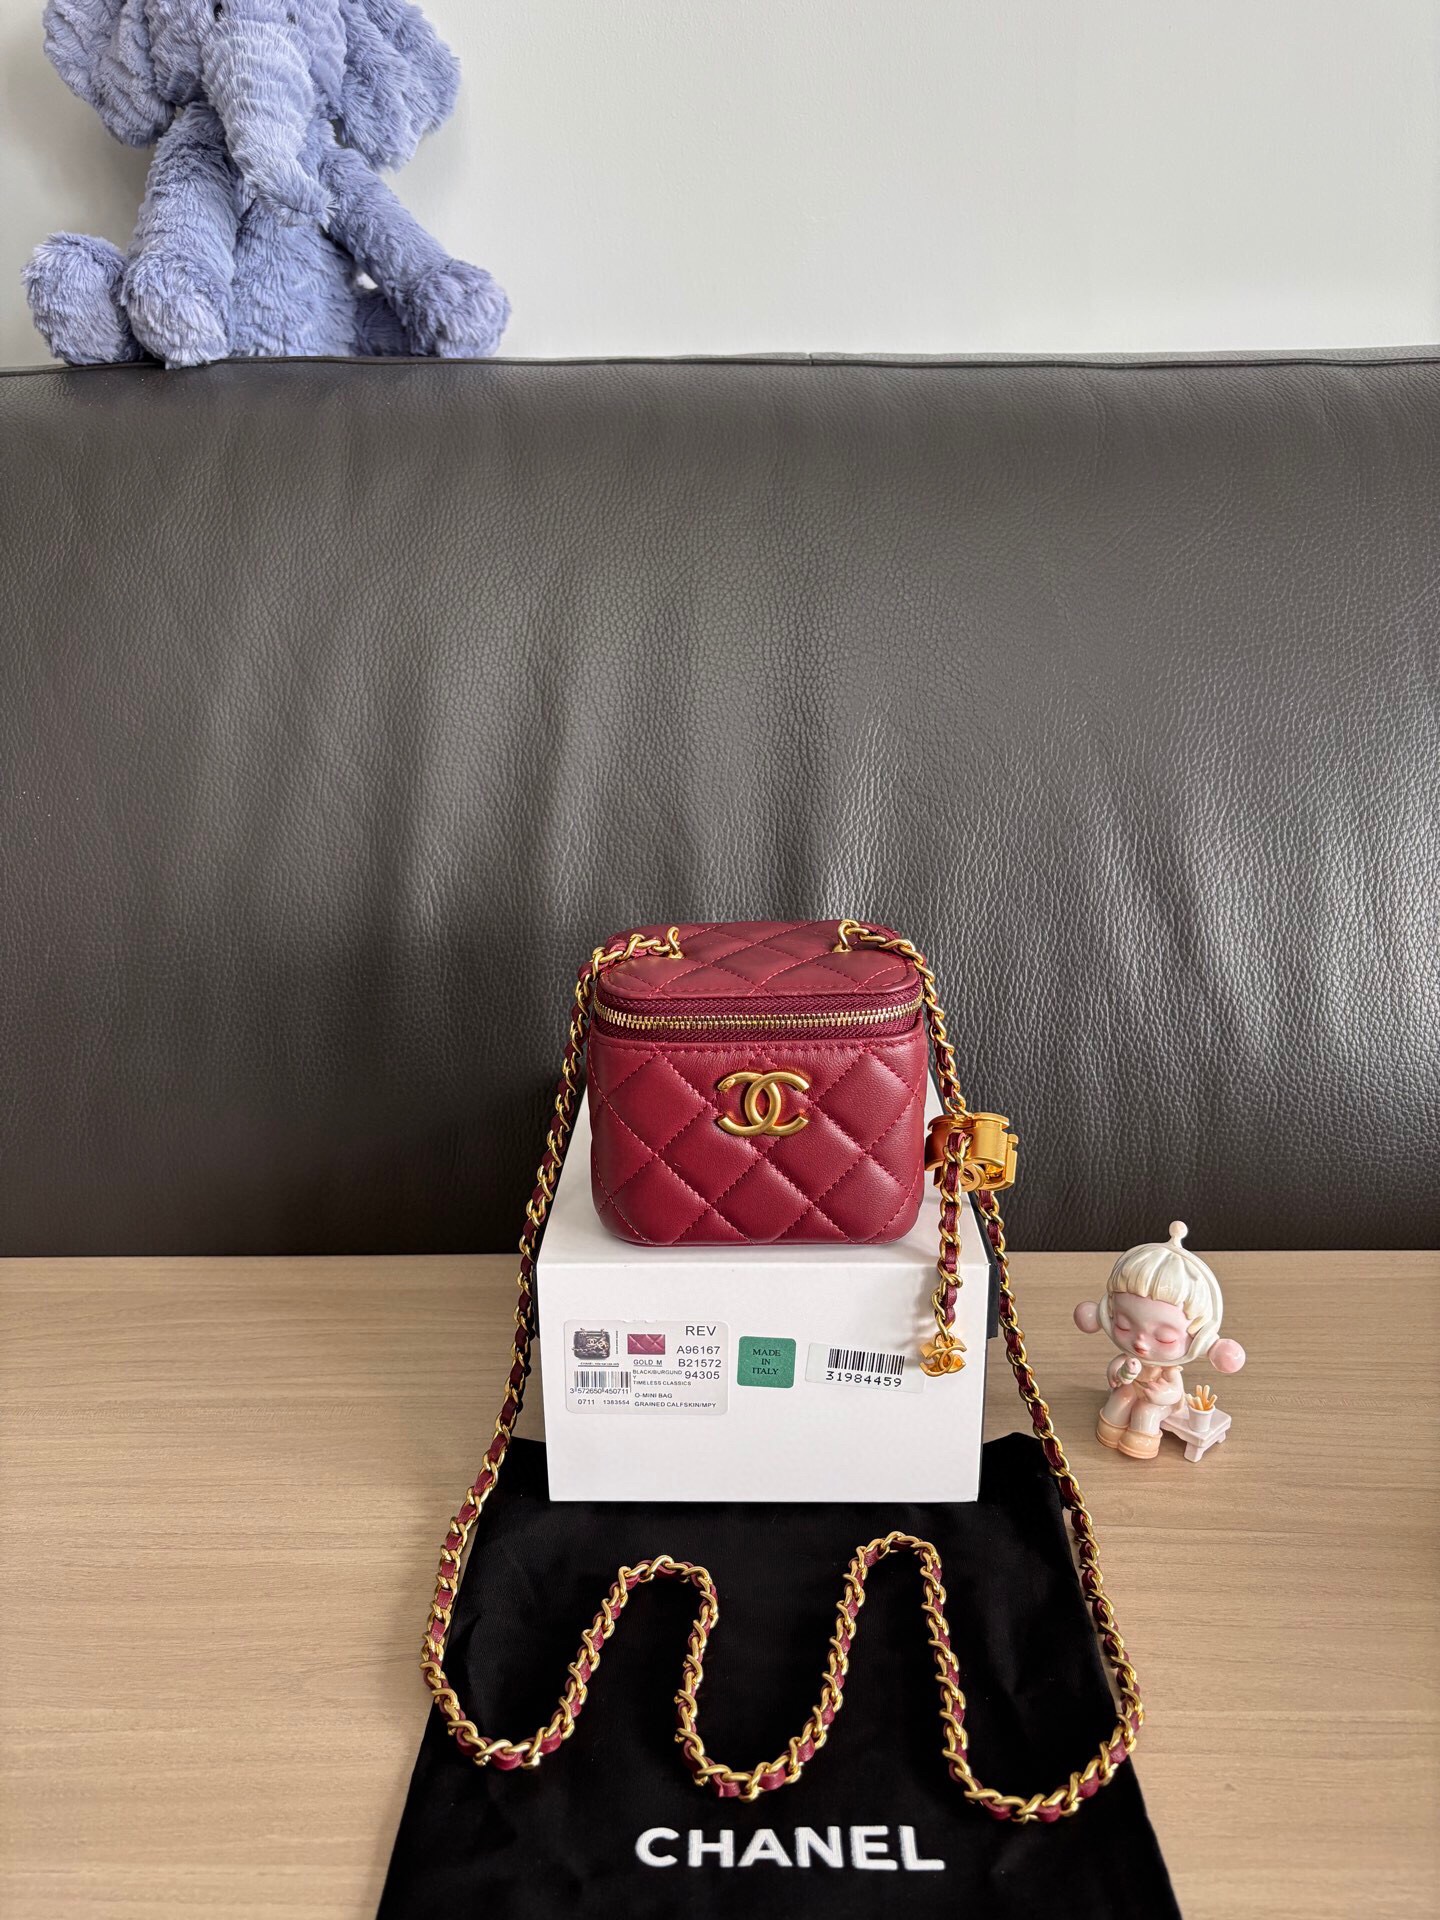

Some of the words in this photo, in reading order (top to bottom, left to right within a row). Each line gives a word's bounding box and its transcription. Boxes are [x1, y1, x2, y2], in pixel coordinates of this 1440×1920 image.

[685, 1325, 717, 1336] REV
[676, 1345, 721, 1355] A96167
[752, 1348, 782, 1357] MADE
[678, 1358, 722, 1368] B21572
[761, 1358, 771, 1366] IN
[684, 1370, 720, 1380] 94305
[752, 1367, 779, 1375] ITALY
[825, 1370, 902, 1388] 31984459
[634, 1824, 946, 1872] CHANEL
